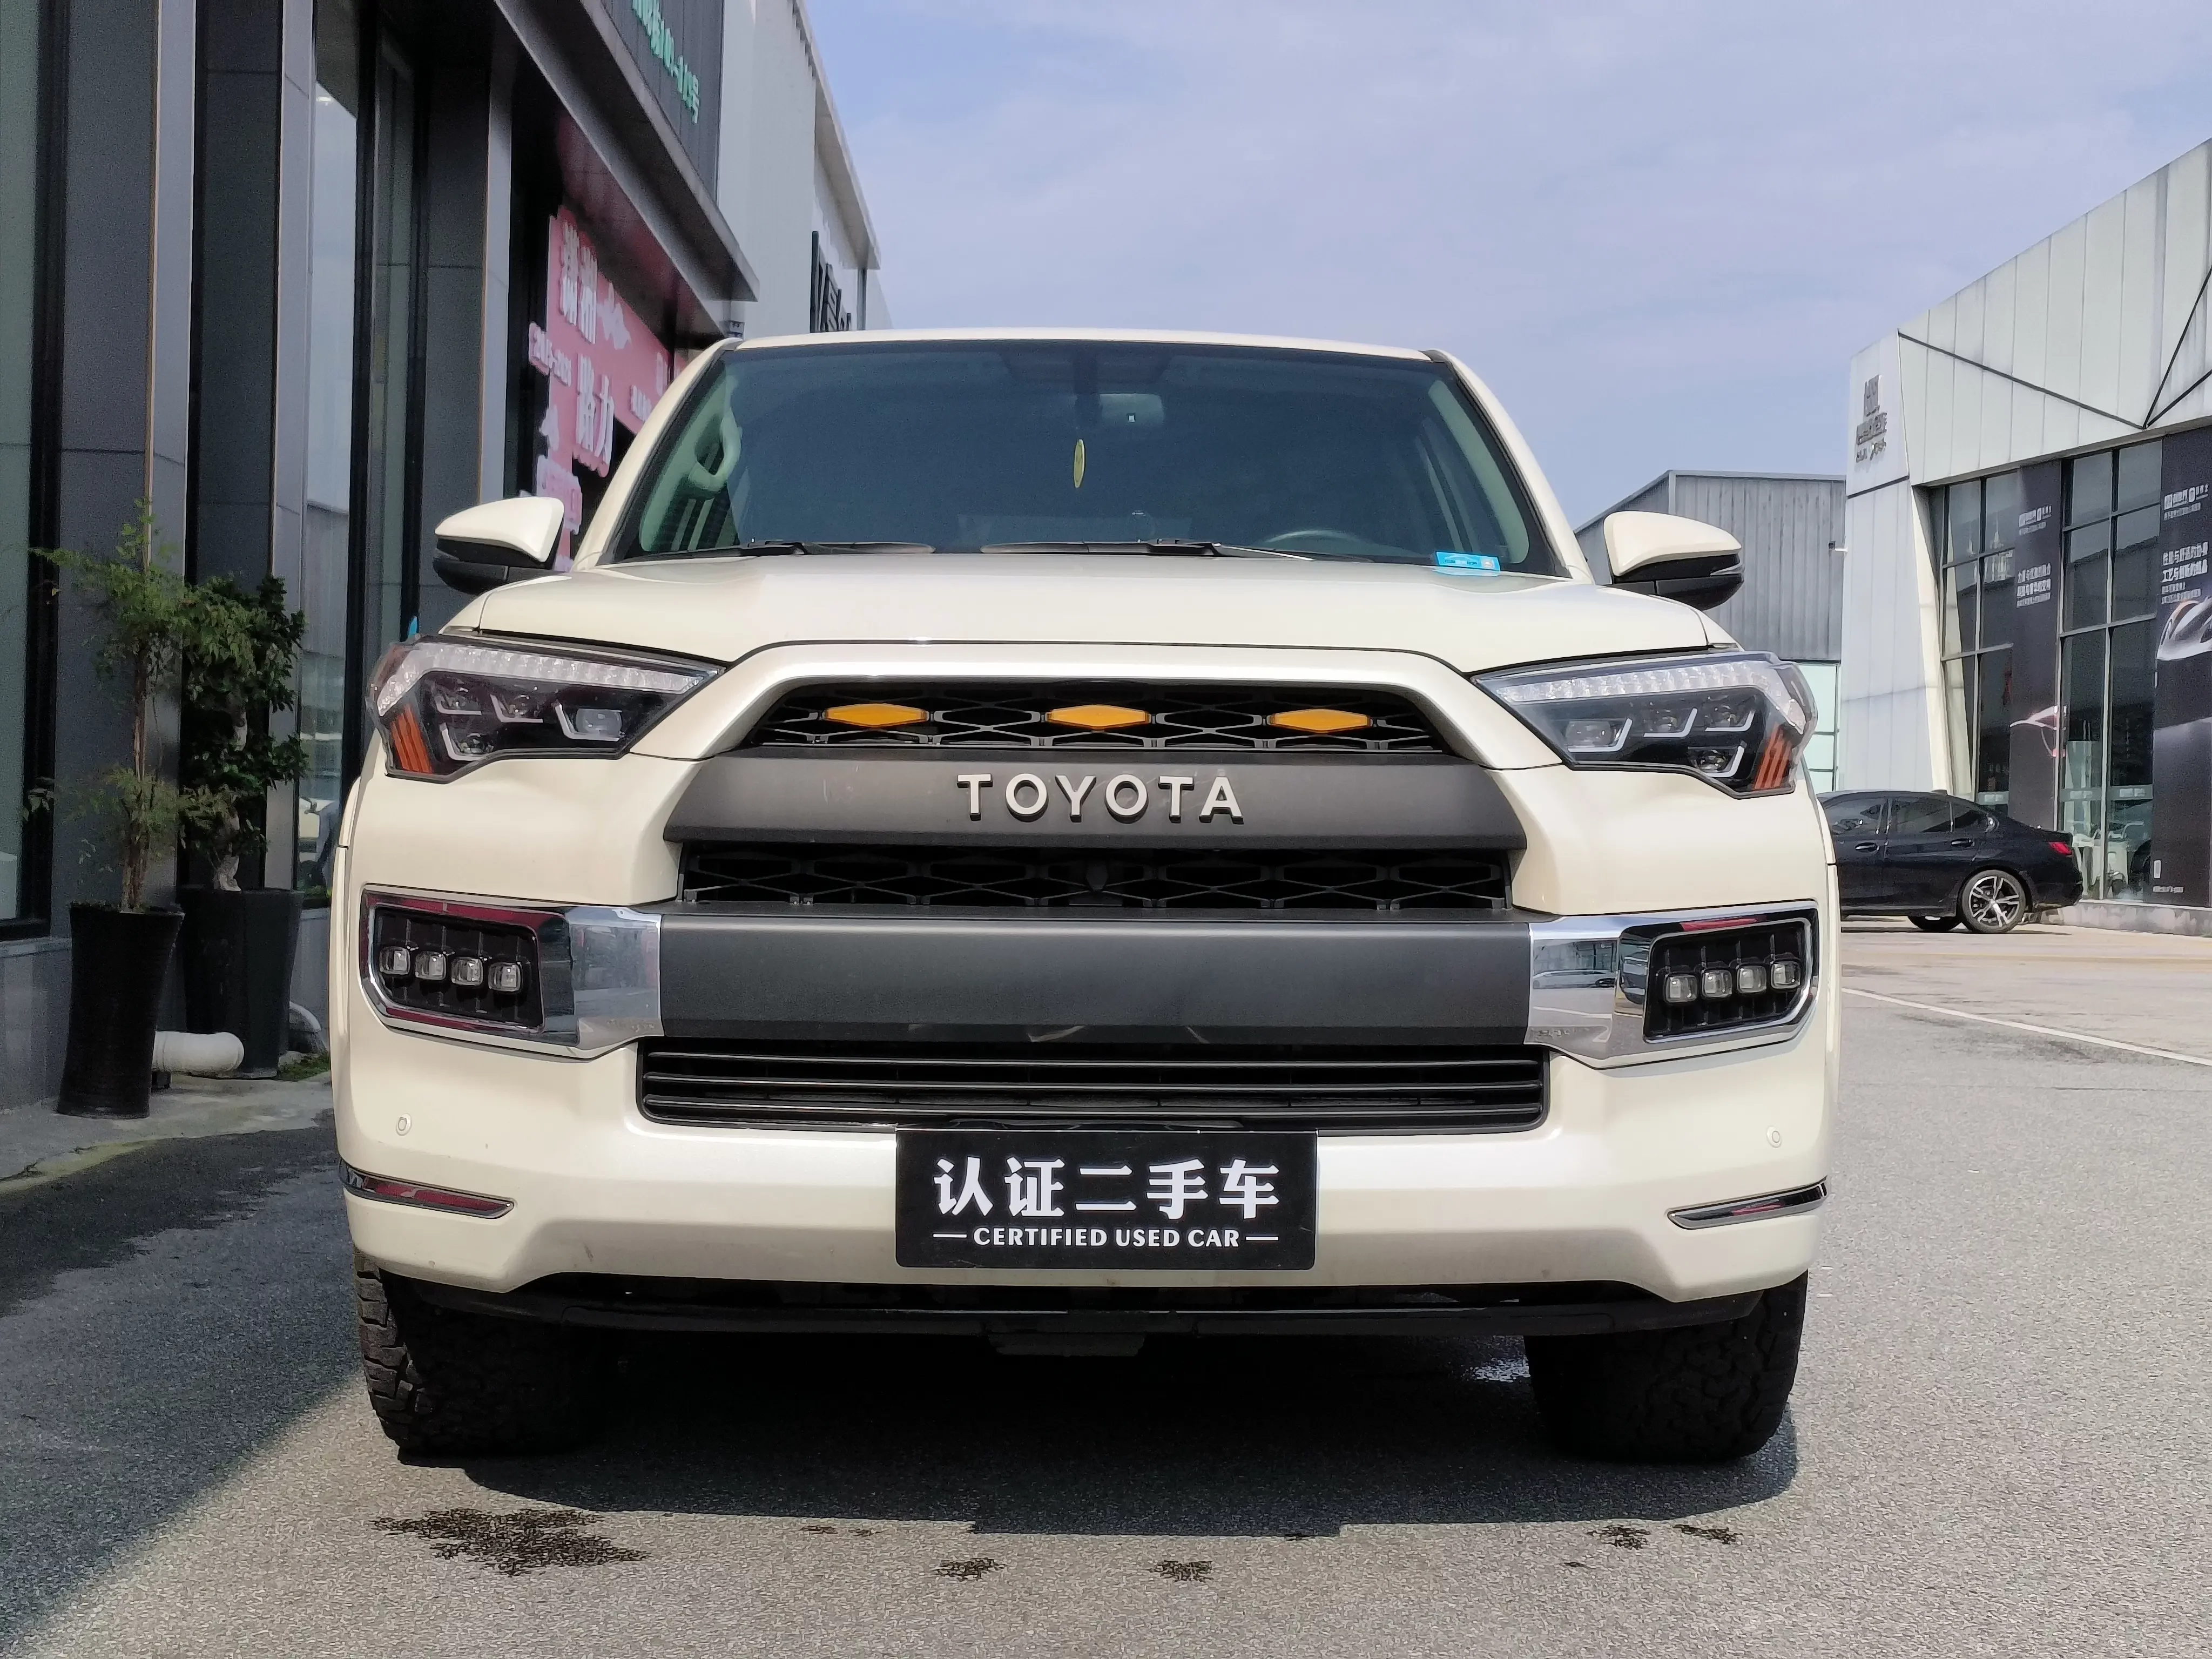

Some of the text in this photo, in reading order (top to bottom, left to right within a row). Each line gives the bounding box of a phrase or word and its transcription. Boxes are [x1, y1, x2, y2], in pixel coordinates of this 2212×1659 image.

[957, 772, 1243, 824] TOYOTA
[933, 1157, 1279, 1219] 认证二手车
[974, 1228, 1239, 1247] CERTIFIED USED CAR
